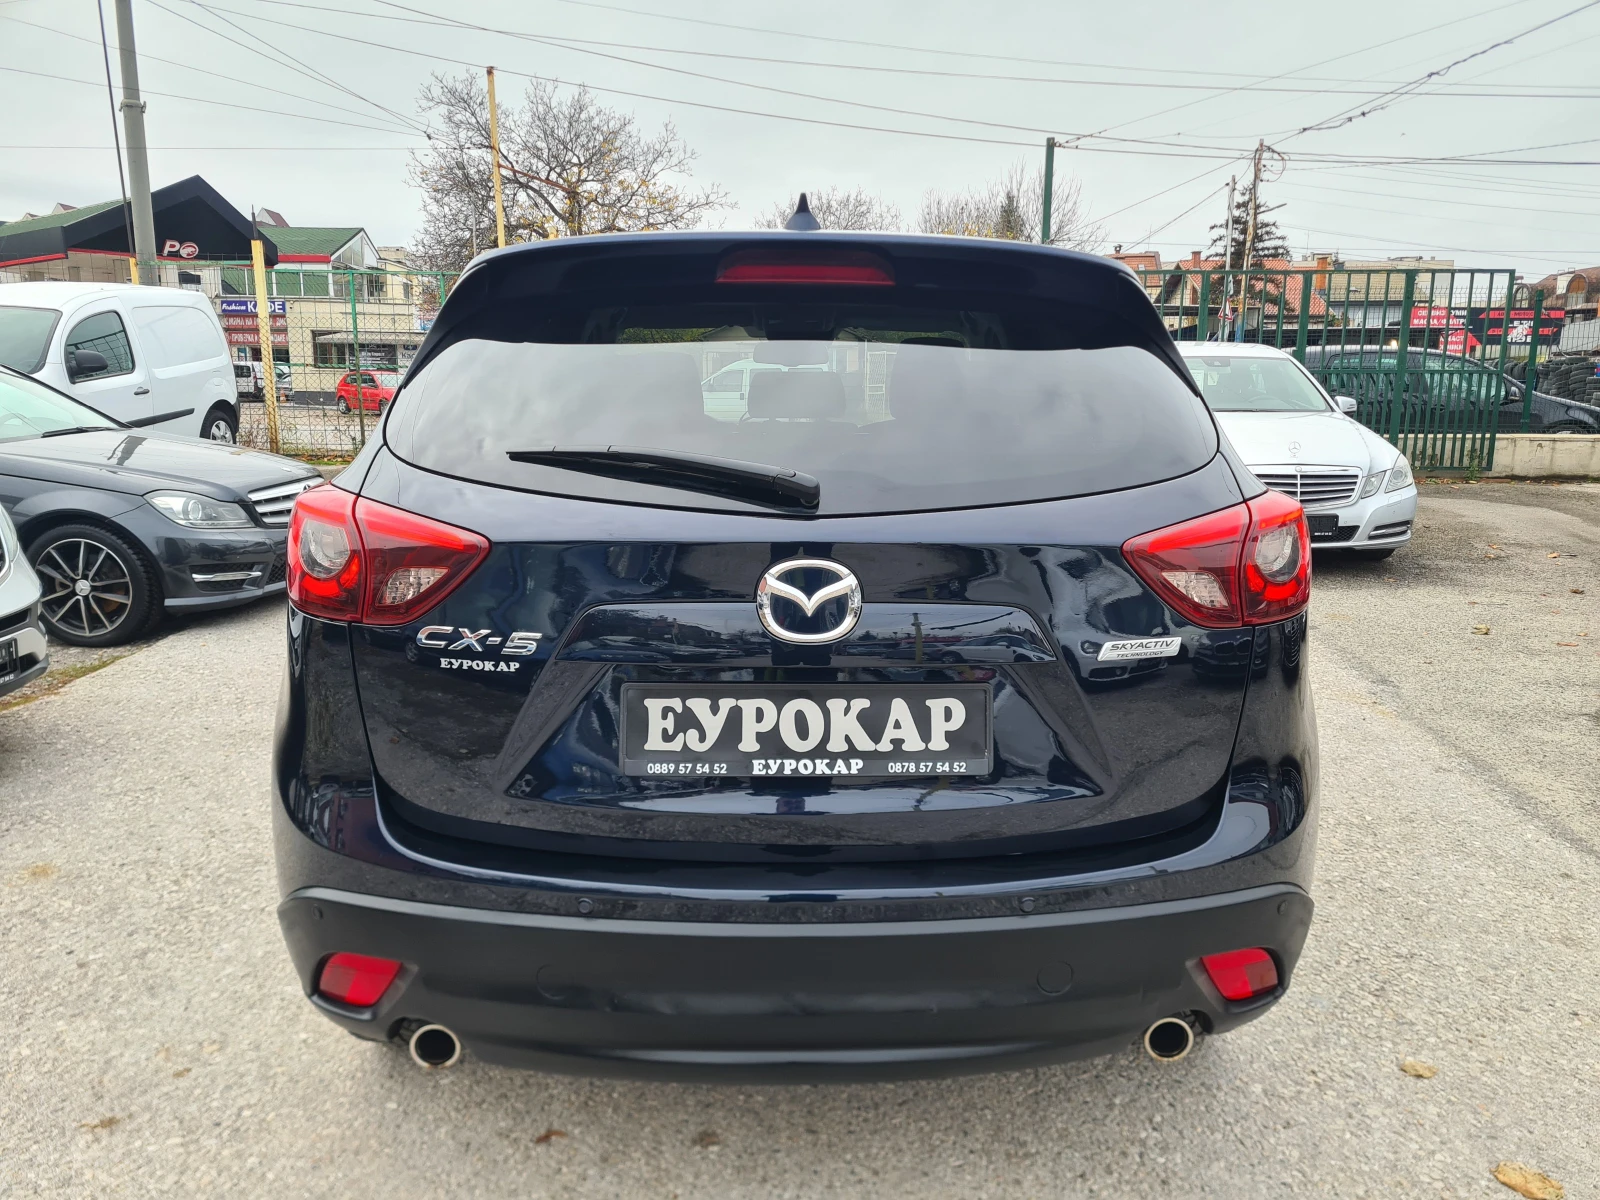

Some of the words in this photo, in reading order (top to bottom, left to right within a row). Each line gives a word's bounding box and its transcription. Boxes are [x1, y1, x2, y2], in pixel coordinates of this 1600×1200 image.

[416, 625, 543, 655] CX-5
[1110, 640, 1175, 651] SKYACTIV
[440, 658, 520, 672] ЕУРОКАР
[643, 698, 966, 752] ЕУРОКАР
[647, 764, 675, 774] 0889
[678, 764, 692, 774] 57
[696, 764, 710, 774] 54
[713, 764, 727, 774] 52
[752, 759, 864, 775] ЕУРОКАР
[888, 763, 916, 773] 0878
[919, 763, 931, 773] 57
[936, 763, 950, 773] 54
[953, 762, 966, 772] 52
